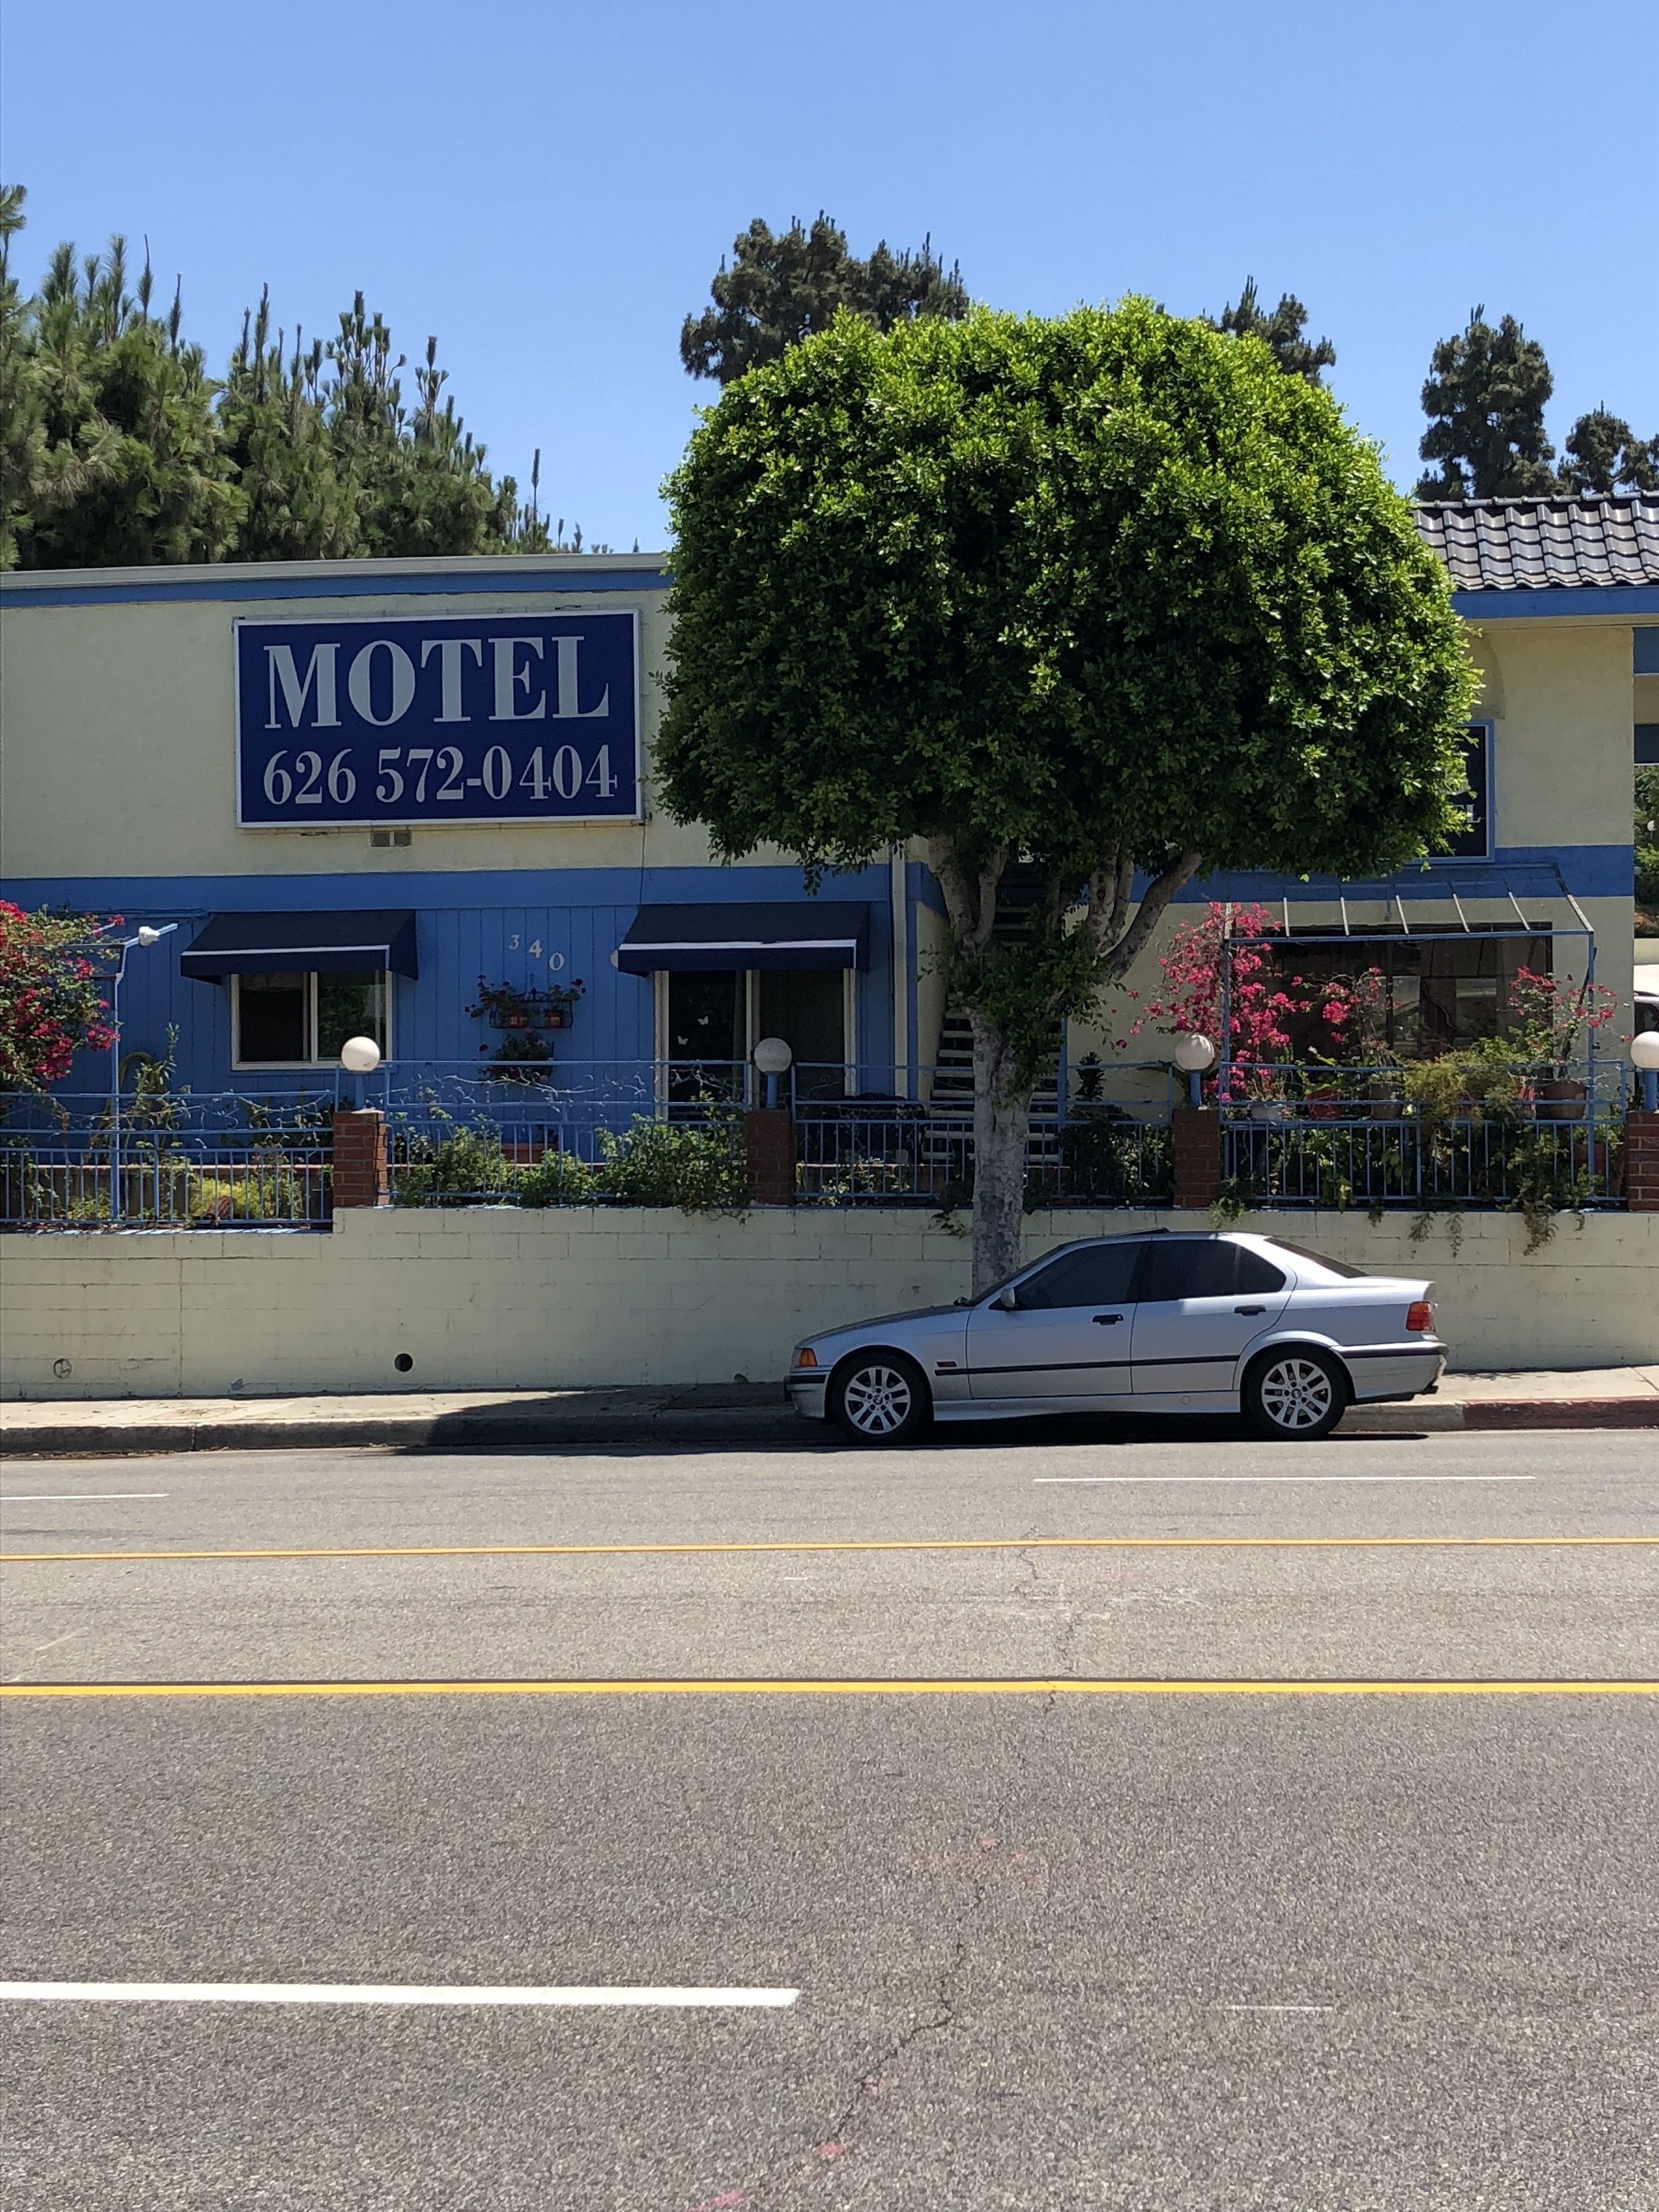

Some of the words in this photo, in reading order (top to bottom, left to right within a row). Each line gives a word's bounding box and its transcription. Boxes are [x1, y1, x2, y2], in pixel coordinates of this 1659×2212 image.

[263, 635, 609, 728] MOTEL
[264, 748, 356, 804] 626
[376, 744, 618, 802] 572-0404
[508, 934, 565, 971] 340
